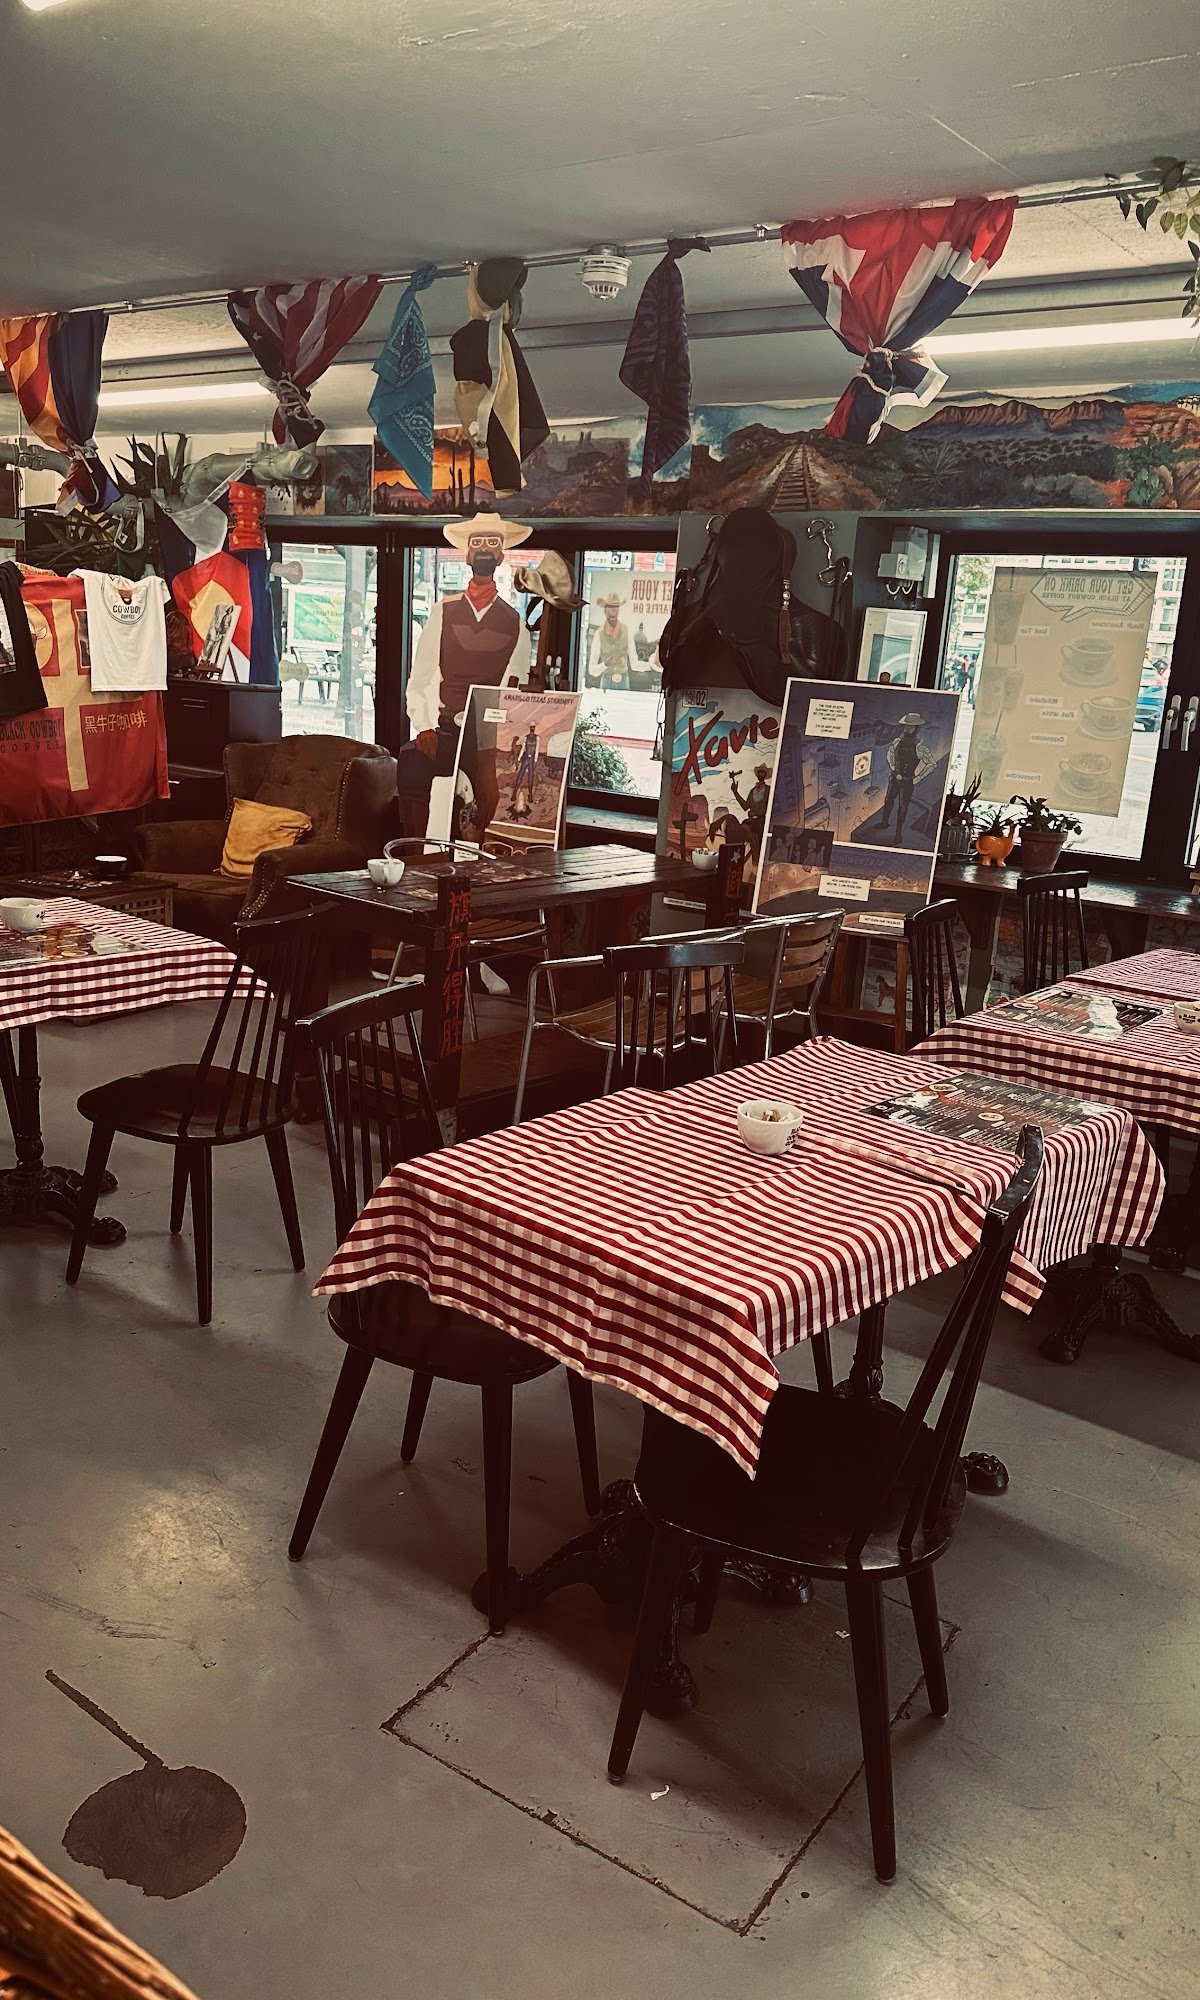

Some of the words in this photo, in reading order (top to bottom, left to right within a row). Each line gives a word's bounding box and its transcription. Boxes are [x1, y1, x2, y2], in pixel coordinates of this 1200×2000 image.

[112, 604, 141, 614] COWBOY
[504, 694, 530, 702] AMARILLO
[546, 697, 574, 705] STANDOFF
[696, 690, 706, 706] 02
[84, 710, 148, 734] 黑牛仔咖啡
[0, 720, 25, 742] BLACK
[29, 719, 63, 739] COWBOY
[0, 740, 60, 753] COFFEE
